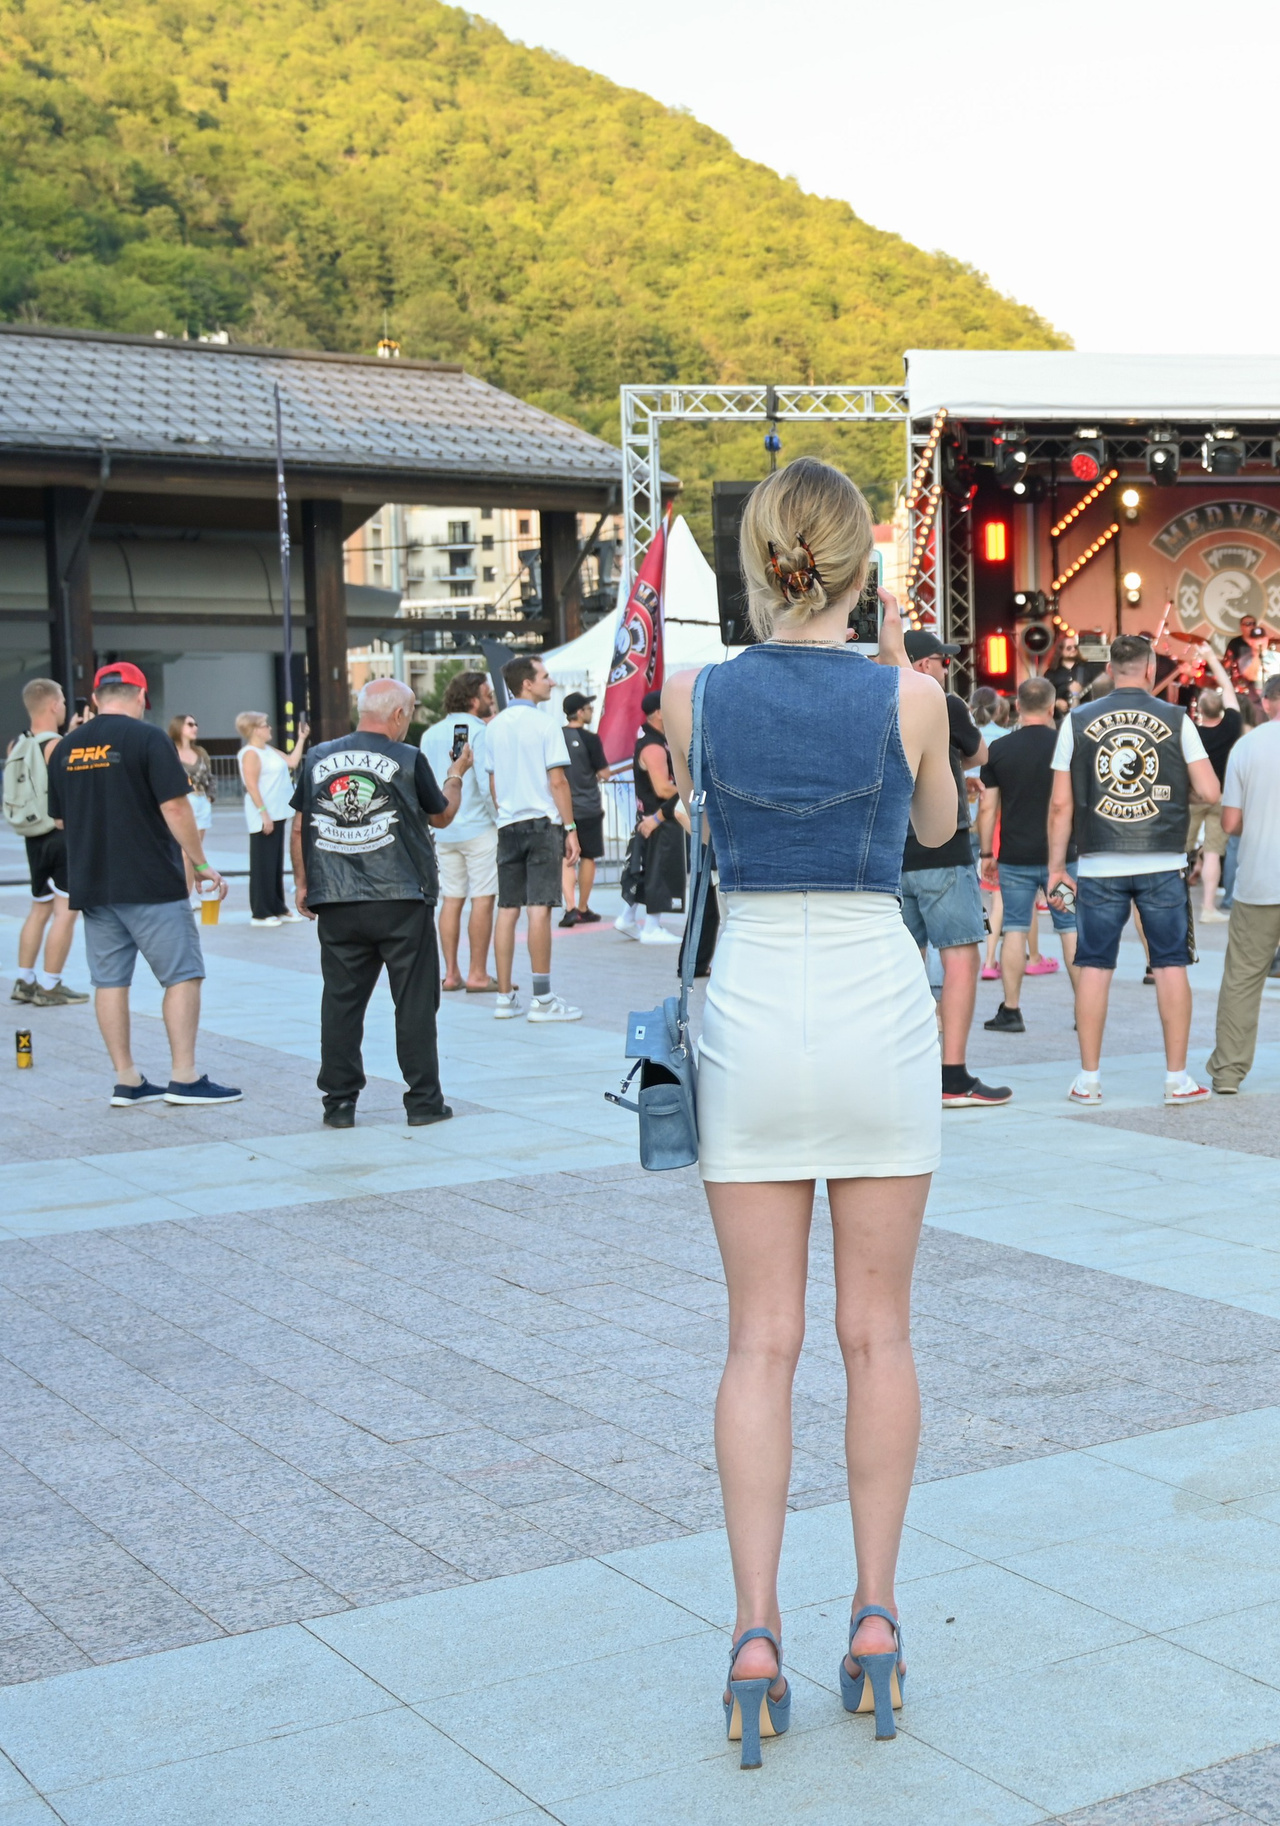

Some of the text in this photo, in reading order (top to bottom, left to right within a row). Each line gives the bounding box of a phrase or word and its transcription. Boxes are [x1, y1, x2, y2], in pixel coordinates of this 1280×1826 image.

[1089, 712, 1167, 737] MEDVEDI
[319, 754, 389, 778] AINAR
[1154, 787, 1169, 798] MC
[1102, 801, 1152, 818] SOCHI
[324, 824, 383, 840] ABKHAZIA
